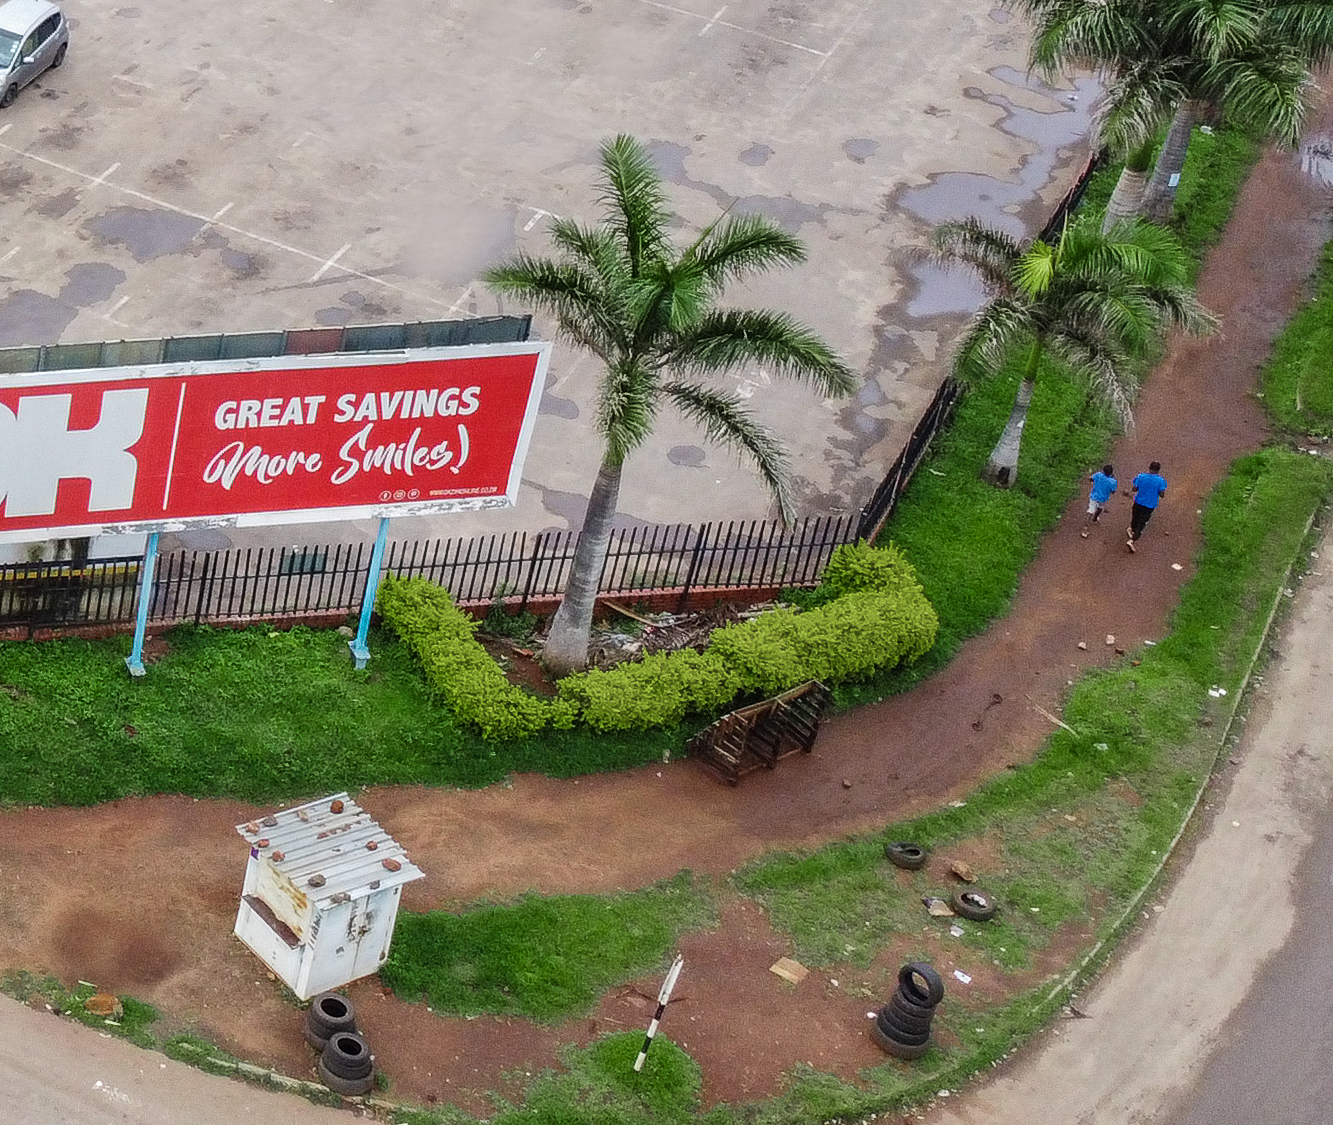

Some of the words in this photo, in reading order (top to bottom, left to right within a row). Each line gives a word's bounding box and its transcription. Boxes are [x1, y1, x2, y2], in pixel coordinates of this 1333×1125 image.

[215, 395, 326, 430] GREAT
[334, 386, 481, 423] SAVINGS
[202, 441, 322, 490] More
